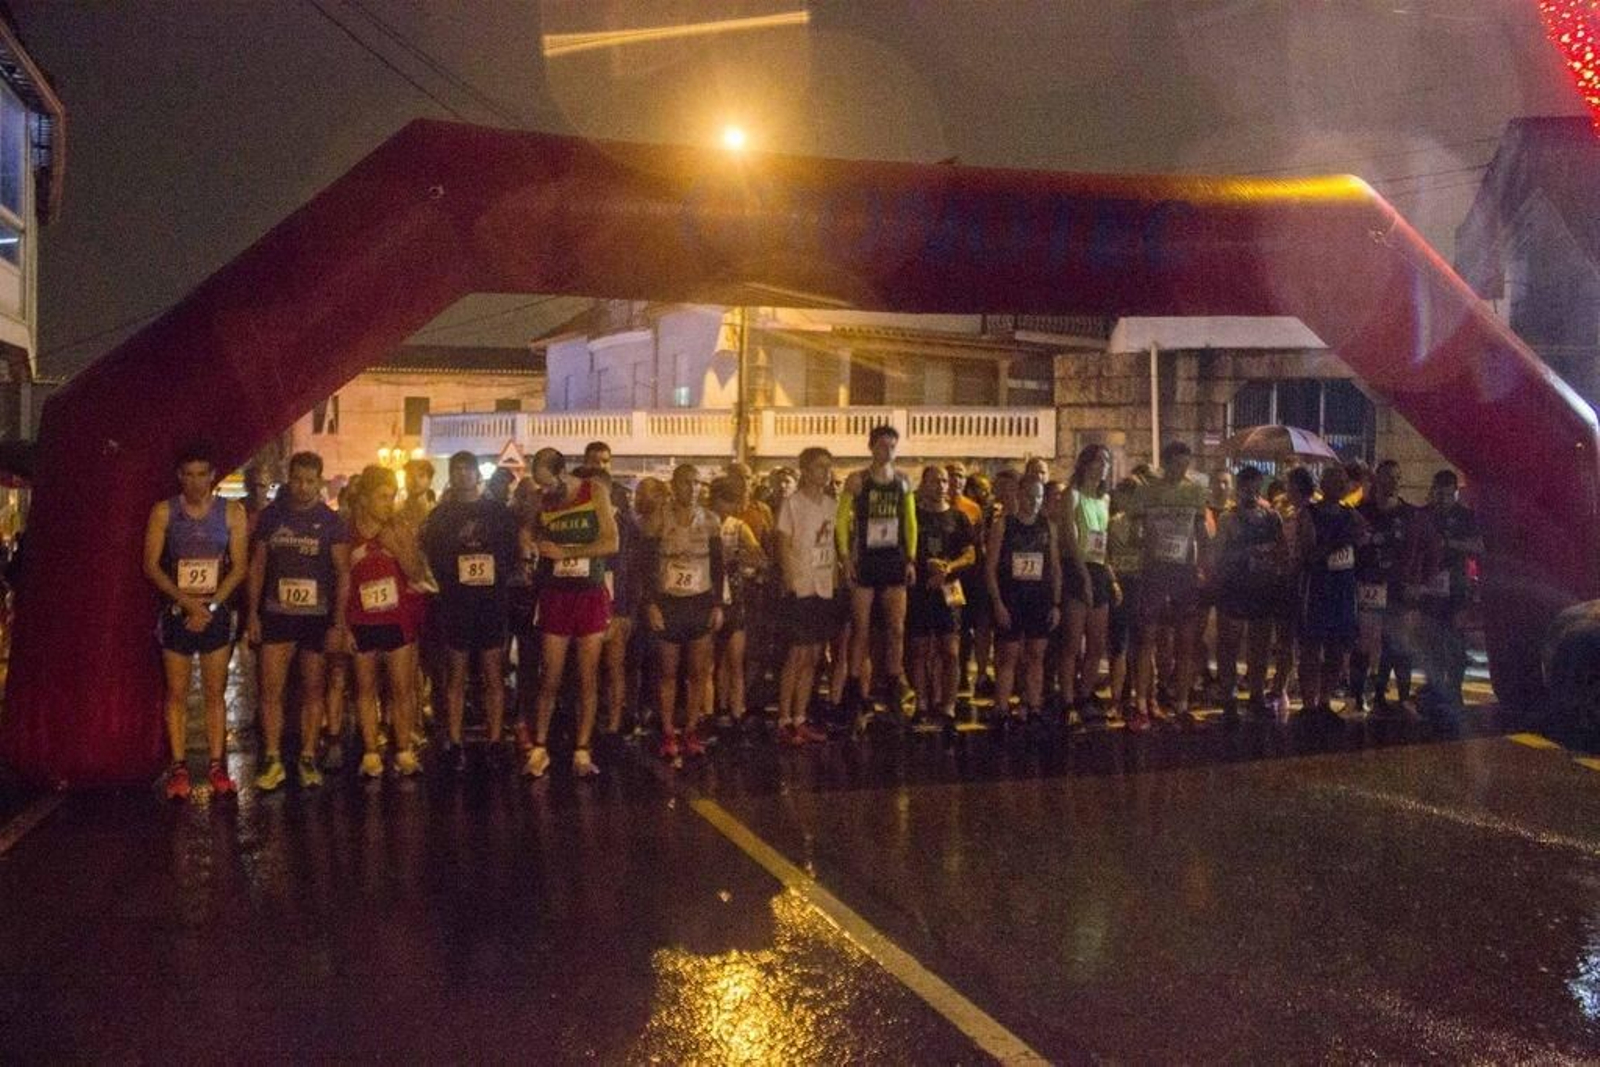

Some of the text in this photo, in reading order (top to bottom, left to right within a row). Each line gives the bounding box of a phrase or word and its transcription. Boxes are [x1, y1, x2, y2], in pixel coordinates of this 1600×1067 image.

[190, 569, 207, 584] 95
[469, 563, 485, 577] 85
[676, 572, 692, 586] 28
[286, 588, 309, 603] 102
[372, 588, 388, 603] 15
